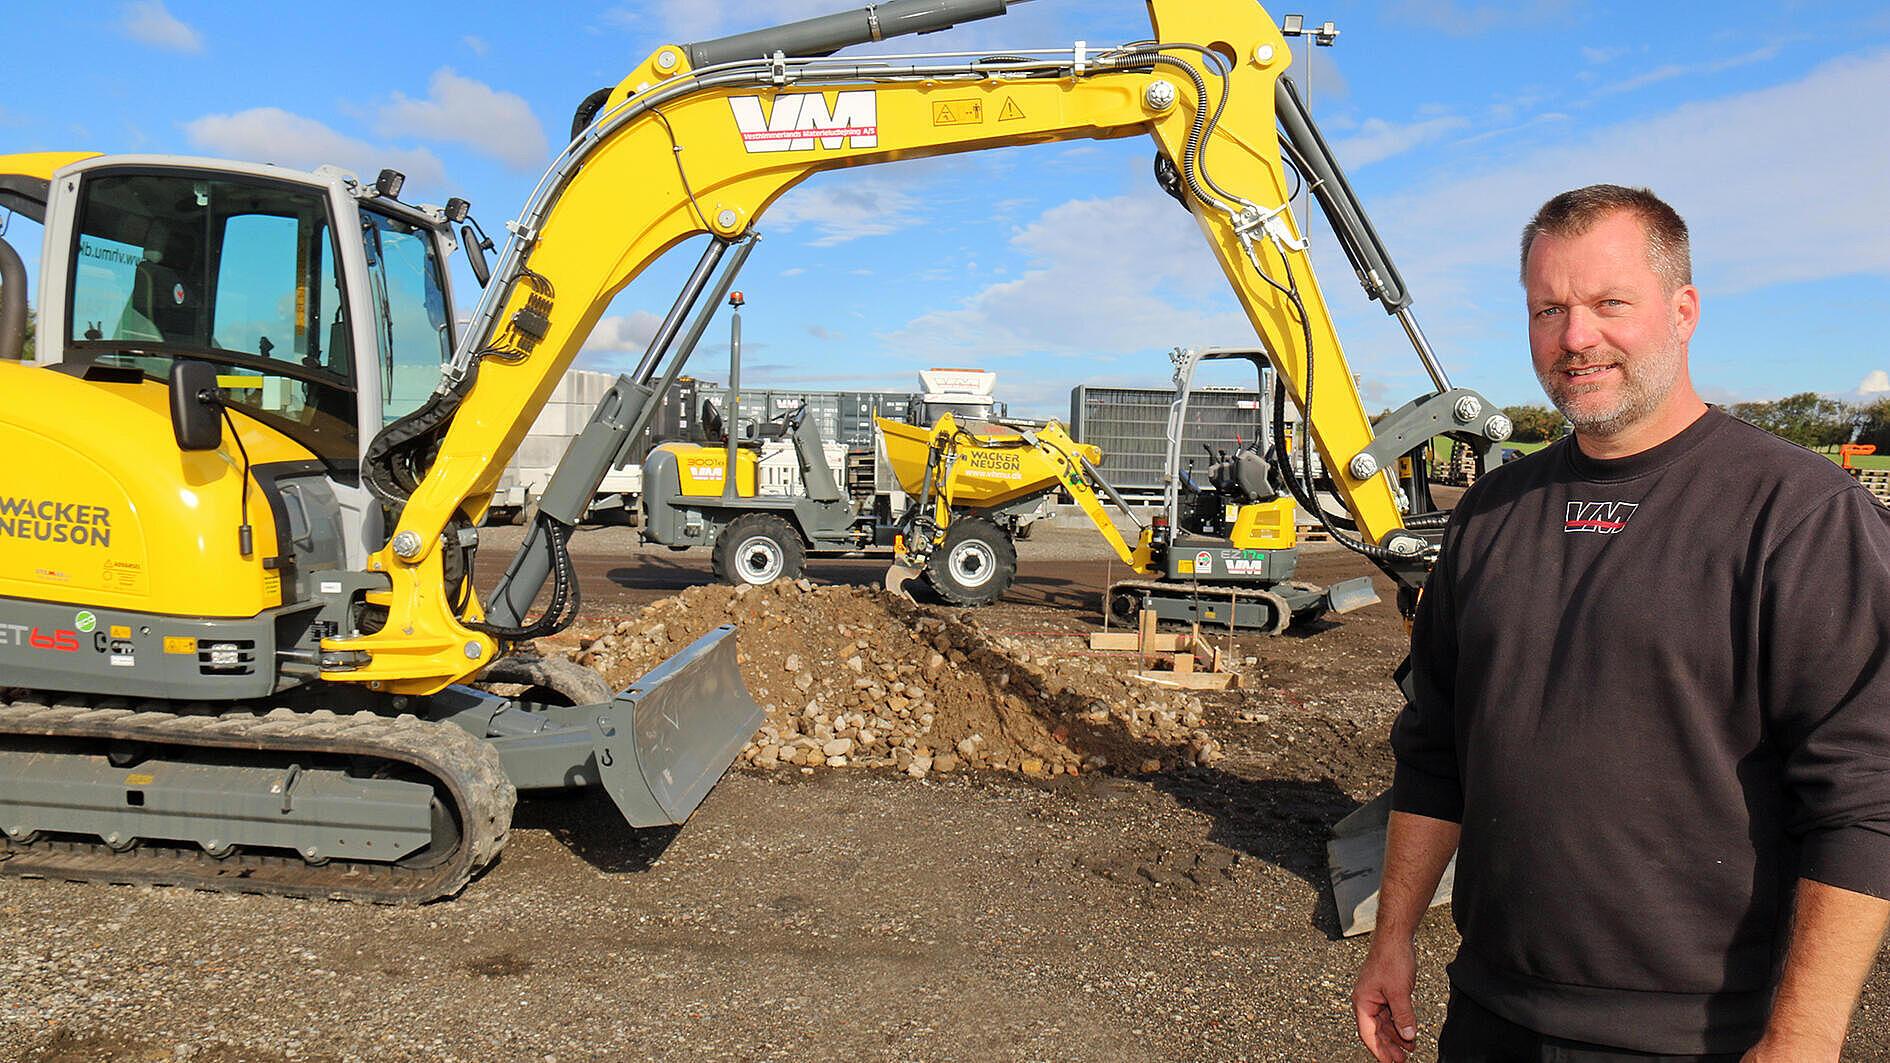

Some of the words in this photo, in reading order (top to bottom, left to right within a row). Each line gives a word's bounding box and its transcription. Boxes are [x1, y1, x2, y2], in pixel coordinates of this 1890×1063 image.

[728, 90, 878, 153] VM
[970, 459, 1020, 470] NEUSON
[971, 451, 1020, 462] WACKER
[0, 496, 111, 527] WACKER
[0, 517, 111, 547] NEUSON
